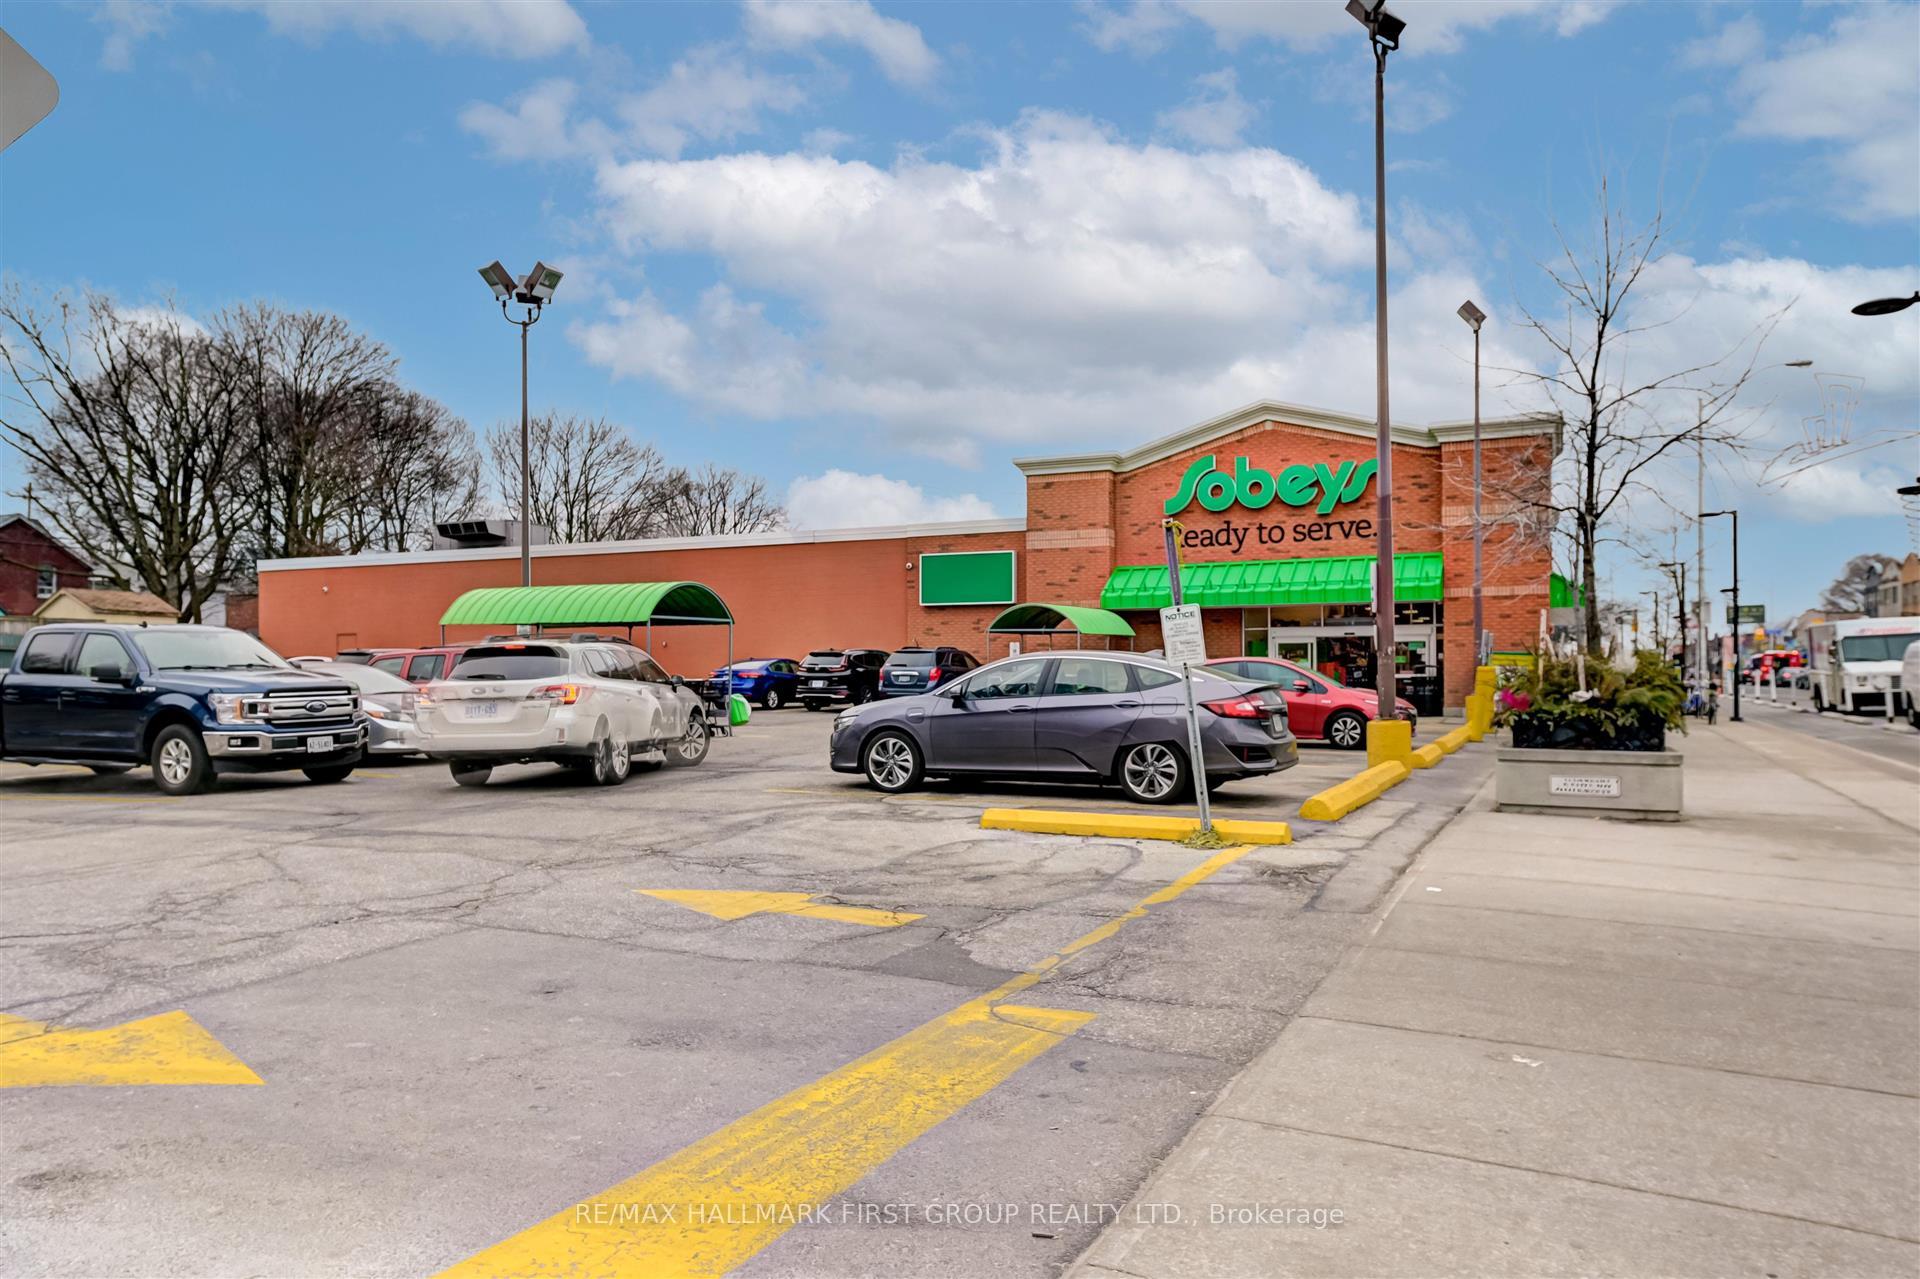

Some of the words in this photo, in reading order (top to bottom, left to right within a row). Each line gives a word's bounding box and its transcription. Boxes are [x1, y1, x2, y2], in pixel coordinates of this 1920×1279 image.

[1163, 454, 1378, 515] Sobeys
[1256, 522, 1285, 544] to
[1292, 517, 1378, 542] serve.
[1165, 610, 1195, 621] NOTICE
